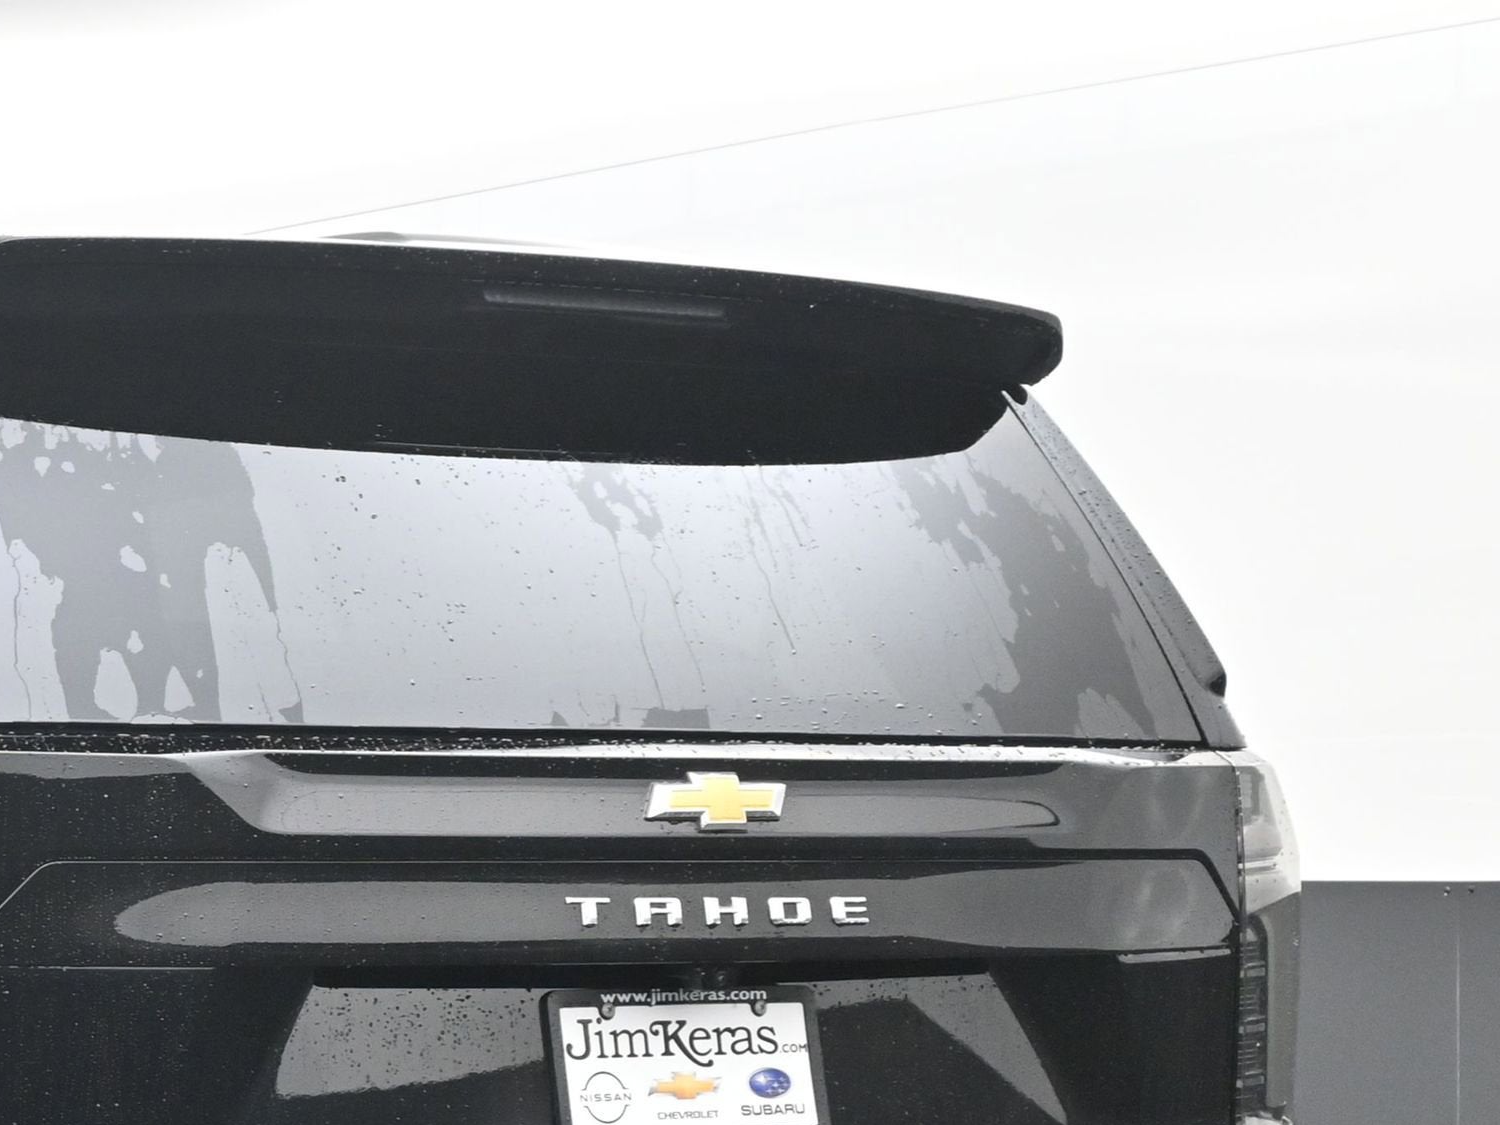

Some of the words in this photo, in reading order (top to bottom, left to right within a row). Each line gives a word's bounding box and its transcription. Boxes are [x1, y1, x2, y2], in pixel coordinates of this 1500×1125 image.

[565, 896, 870, 927] TAHOE
[600, 988, 768, 1006] www.jimkeras.com
[580, 1093, 632, 1102] NISSAN
[657, 1110, 719, 1120] CHEVROLET
[741, 1104, 805, 1116] SUBARU
